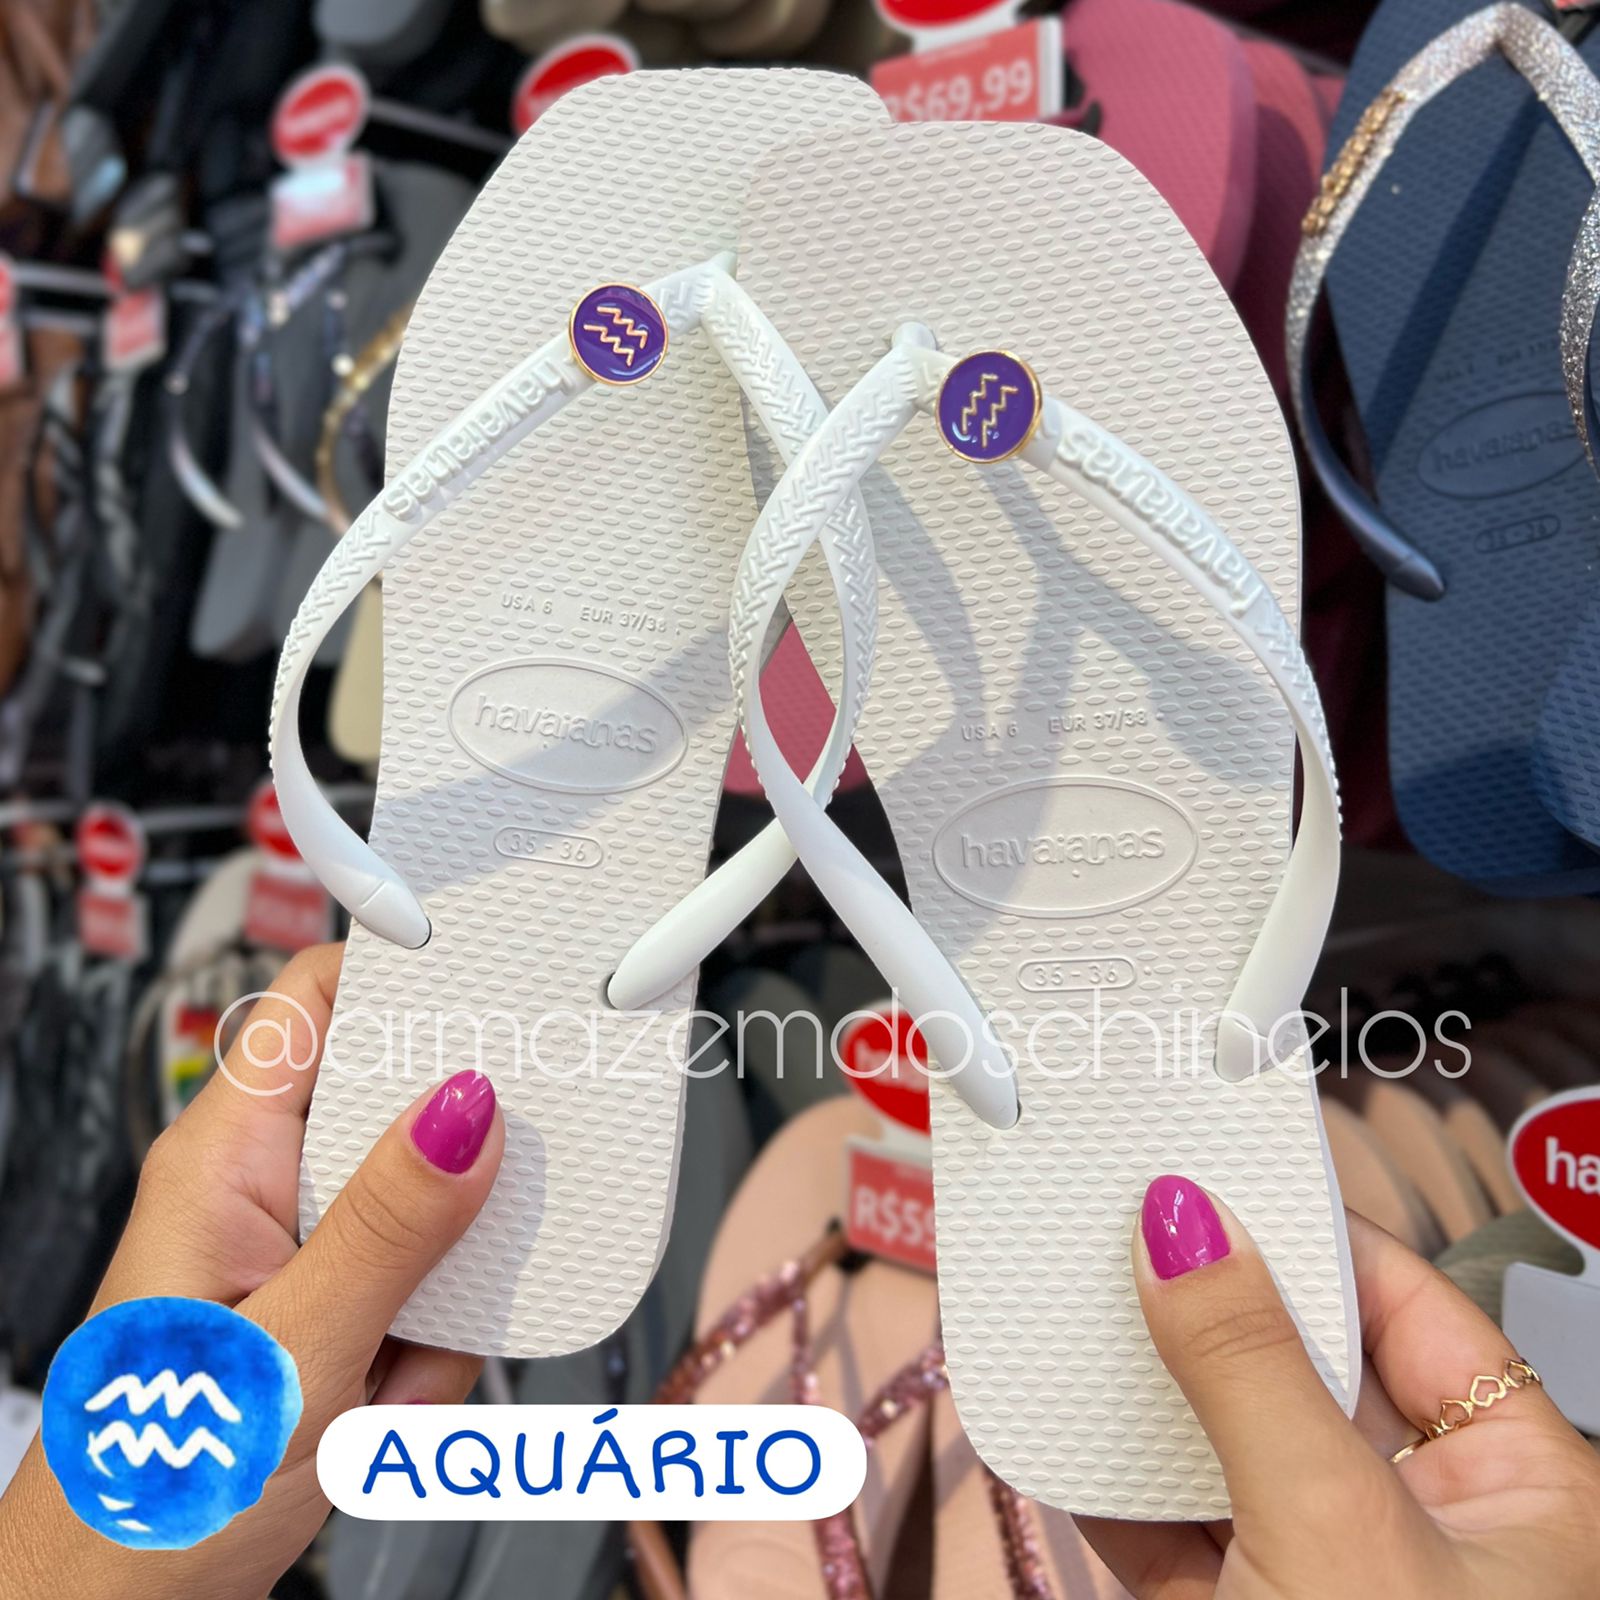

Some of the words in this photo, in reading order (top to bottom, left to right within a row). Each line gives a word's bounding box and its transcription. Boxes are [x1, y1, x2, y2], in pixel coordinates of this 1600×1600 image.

[383, 358, 577, 521] havaianas
[1056, 431, 1264, 618] havaianas
[501, 592, 535, 612] USA
[543, 600, 553, 615] 6
[580, 606, 613, 625] EUR
[474, 693, 658, 755] havaianas
[961, 721, 1000, 742] USA
[1007, 721, 1019, 738] 6
[1048, 714, 1086, 735] EUR
[510, 832, 538, 854] 35
[560, 840, 587, 862] 36
[960, 828, 1167, 869] havaianas
[1033, 963, 1064, 987] 35
[1089, 961, 1119, 984] 36
